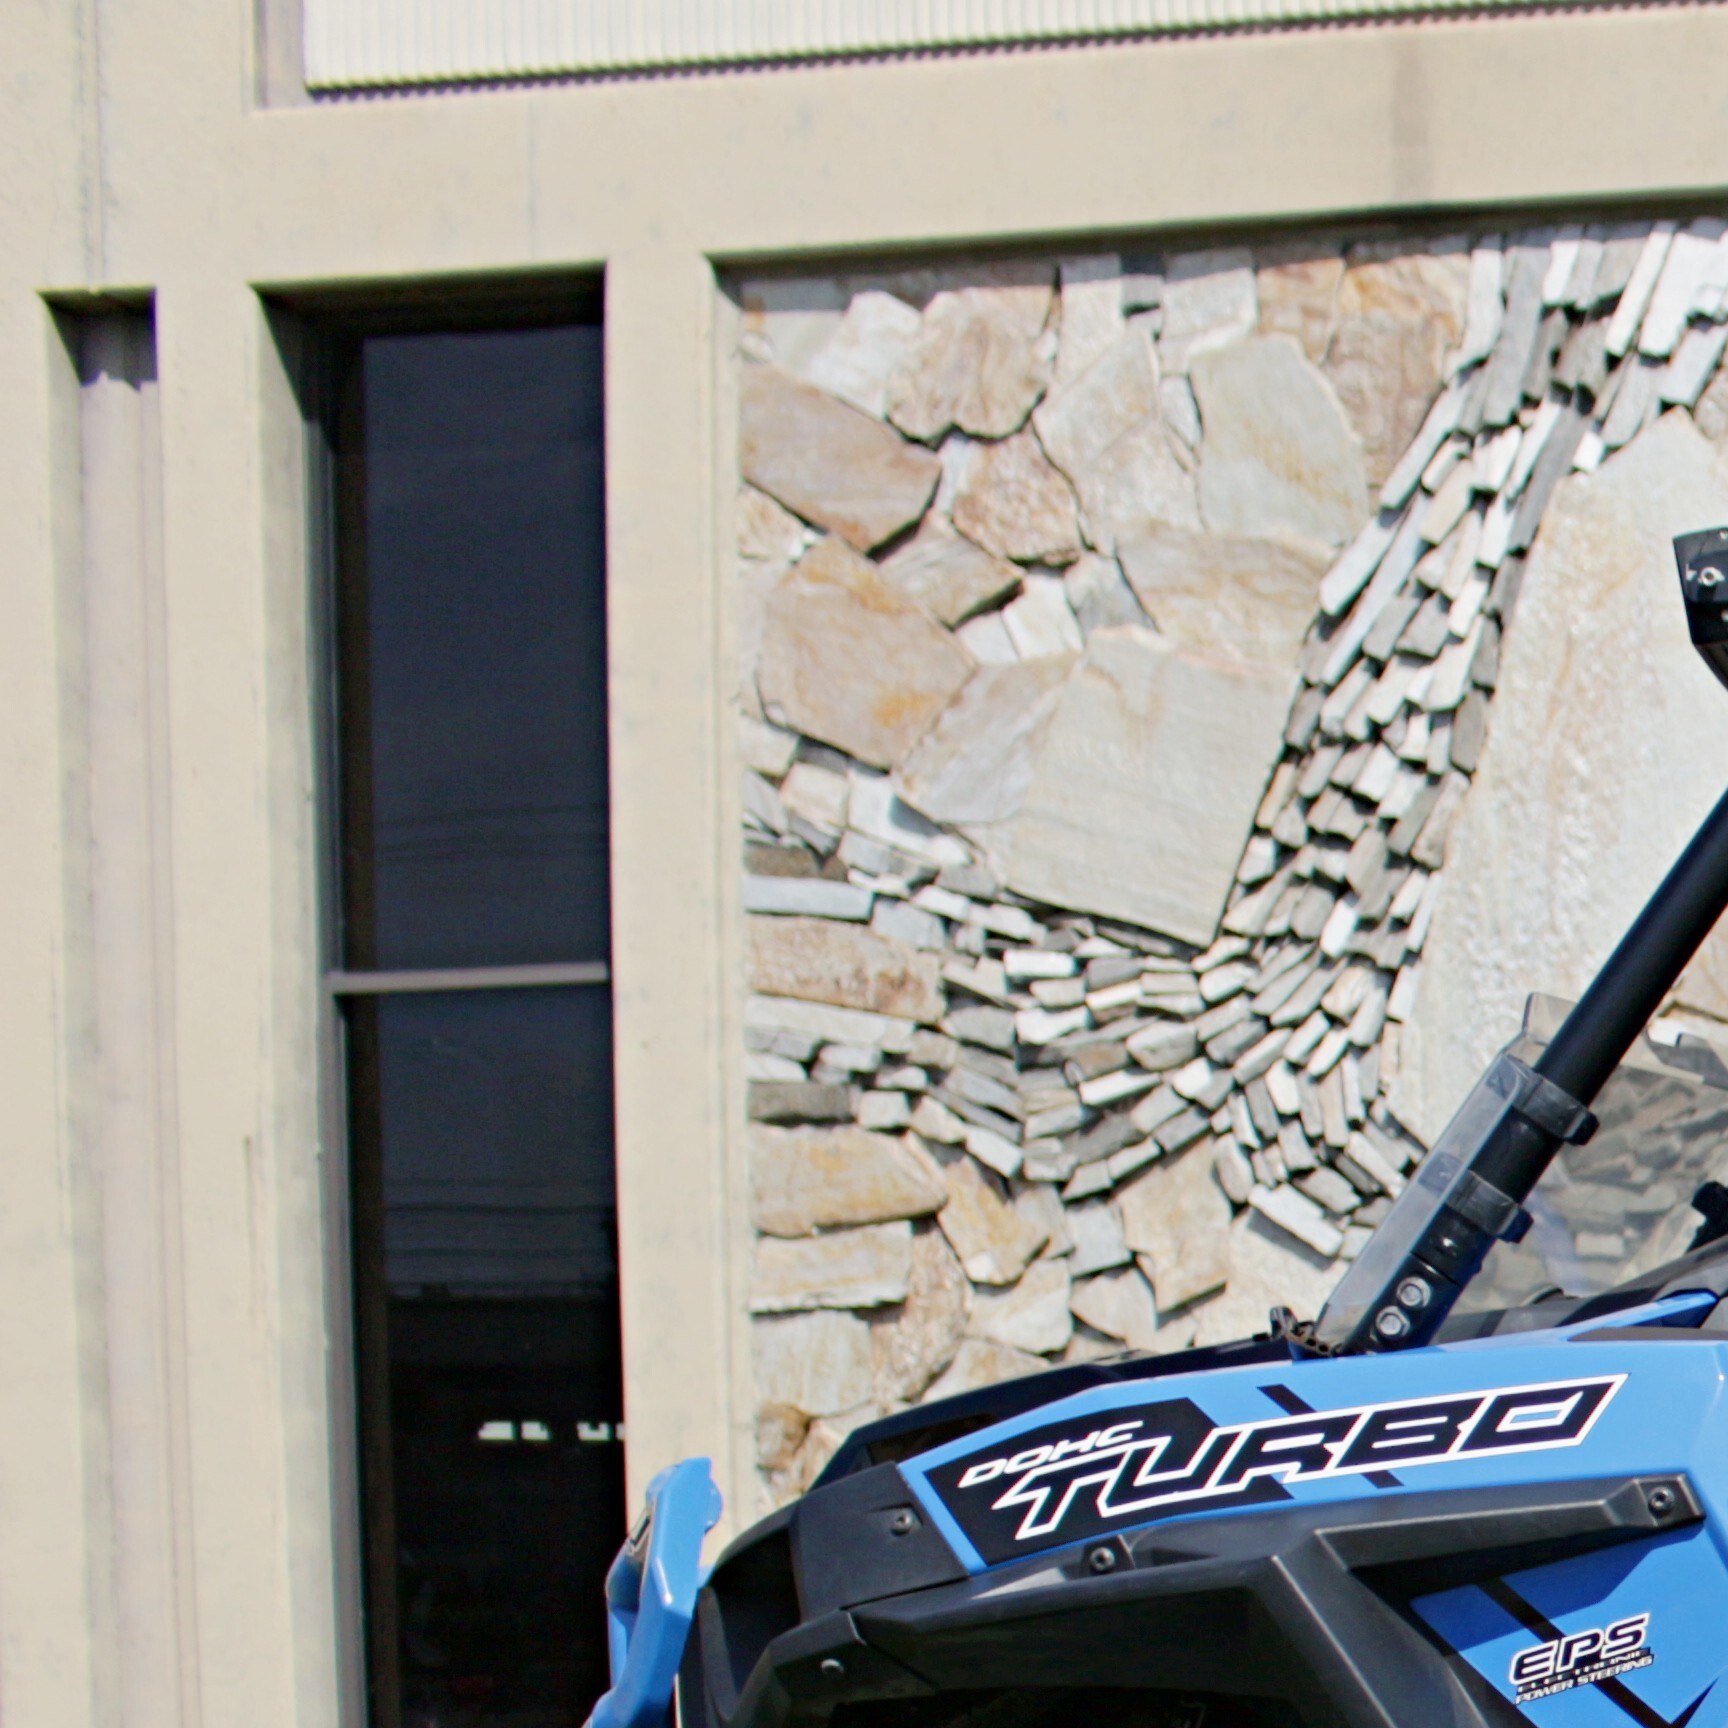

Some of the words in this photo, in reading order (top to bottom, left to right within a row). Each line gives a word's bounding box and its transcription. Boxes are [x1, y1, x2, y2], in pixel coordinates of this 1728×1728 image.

[957, 1420, 1083, 1488] DOHC
[991, 1373, 1629, 1540] TURBO
[1508, 1612, 1651, 1685] EPS
[1515, 1678, 1574, 1704] POWER
[1576, 1655, 1654, 1686] STEERING
